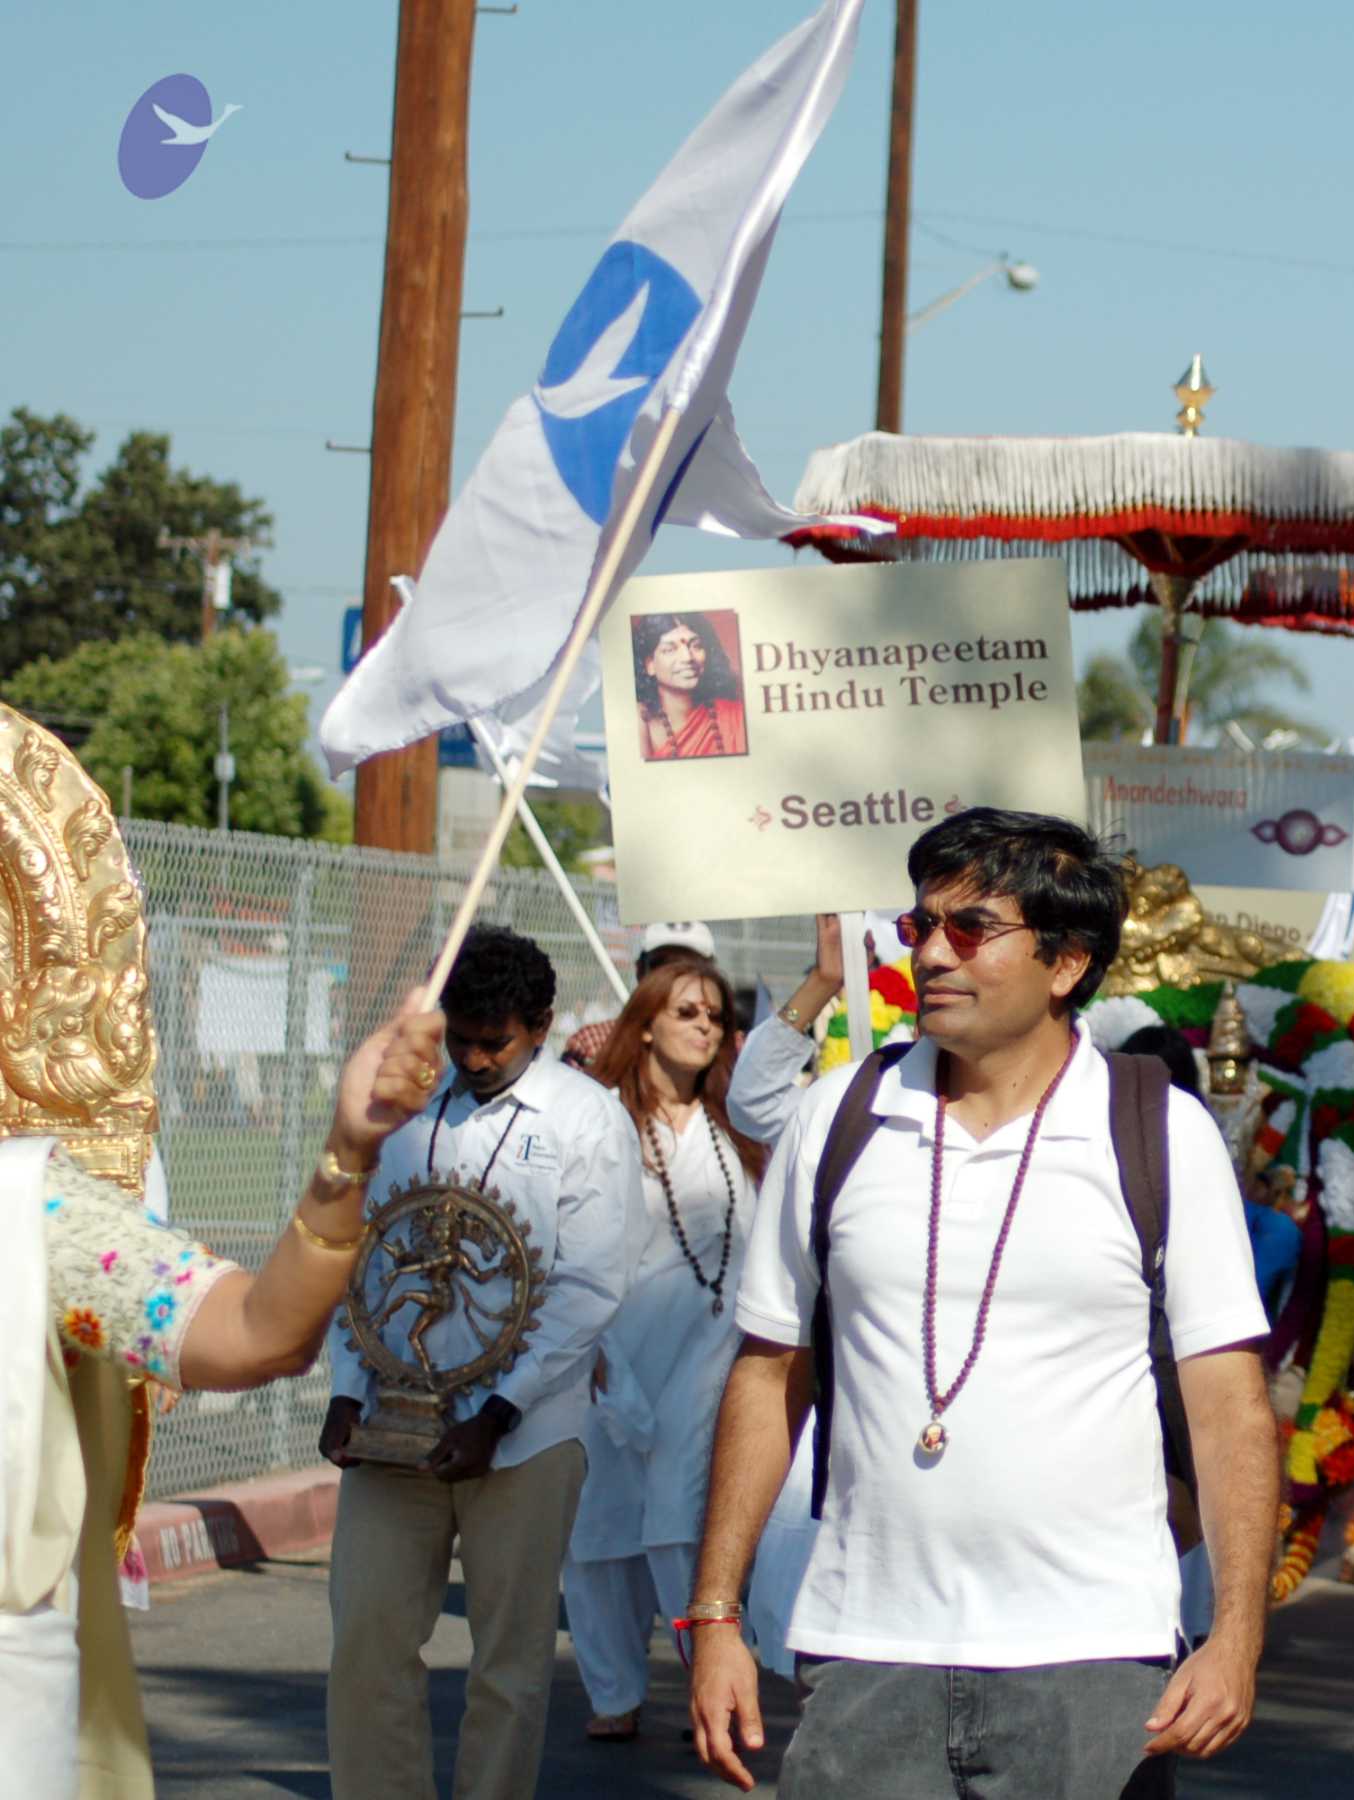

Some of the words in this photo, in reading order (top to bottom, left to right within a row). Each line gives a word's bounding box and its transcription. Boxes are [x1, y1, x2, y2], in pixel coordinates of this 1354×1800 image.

[753, 635, 1048, 677] Dhyanapeetam
[761, 680, 885, 714] Hindu
[900, 673, 1048, 710] Temple
[781, 789, 935, 830] Seattle
[160, 1527, 181, 1569] NO
